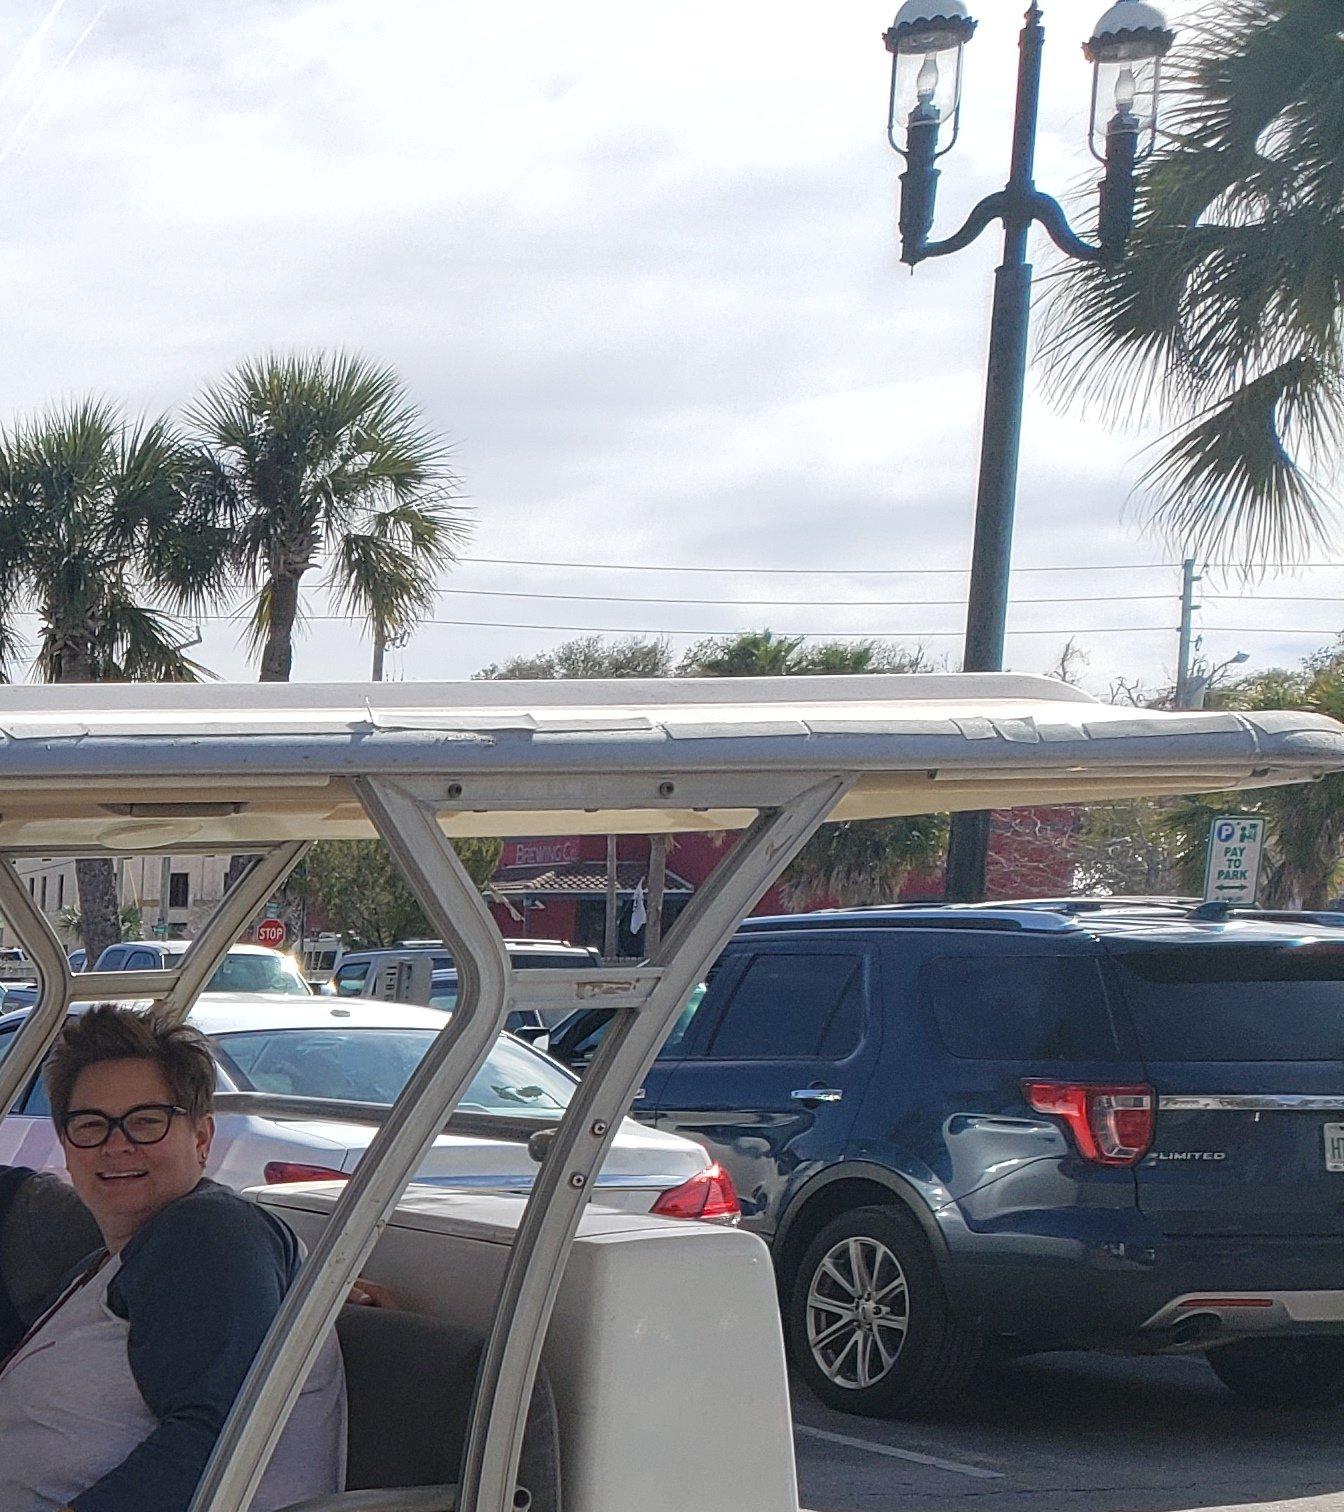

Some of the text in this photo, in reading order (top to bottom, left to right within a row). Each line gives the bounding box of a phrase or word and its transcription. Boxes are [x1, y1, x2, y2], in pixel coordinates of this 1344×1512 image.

[1224, 847, 1246, 858] PAY
[1227, 859, 1242, 869] TO
[1217, 870, 1248, 880] PARK
[259, 927, 283, 940] STOP
[1159, 1152, 1226, 1160] LIMITED
